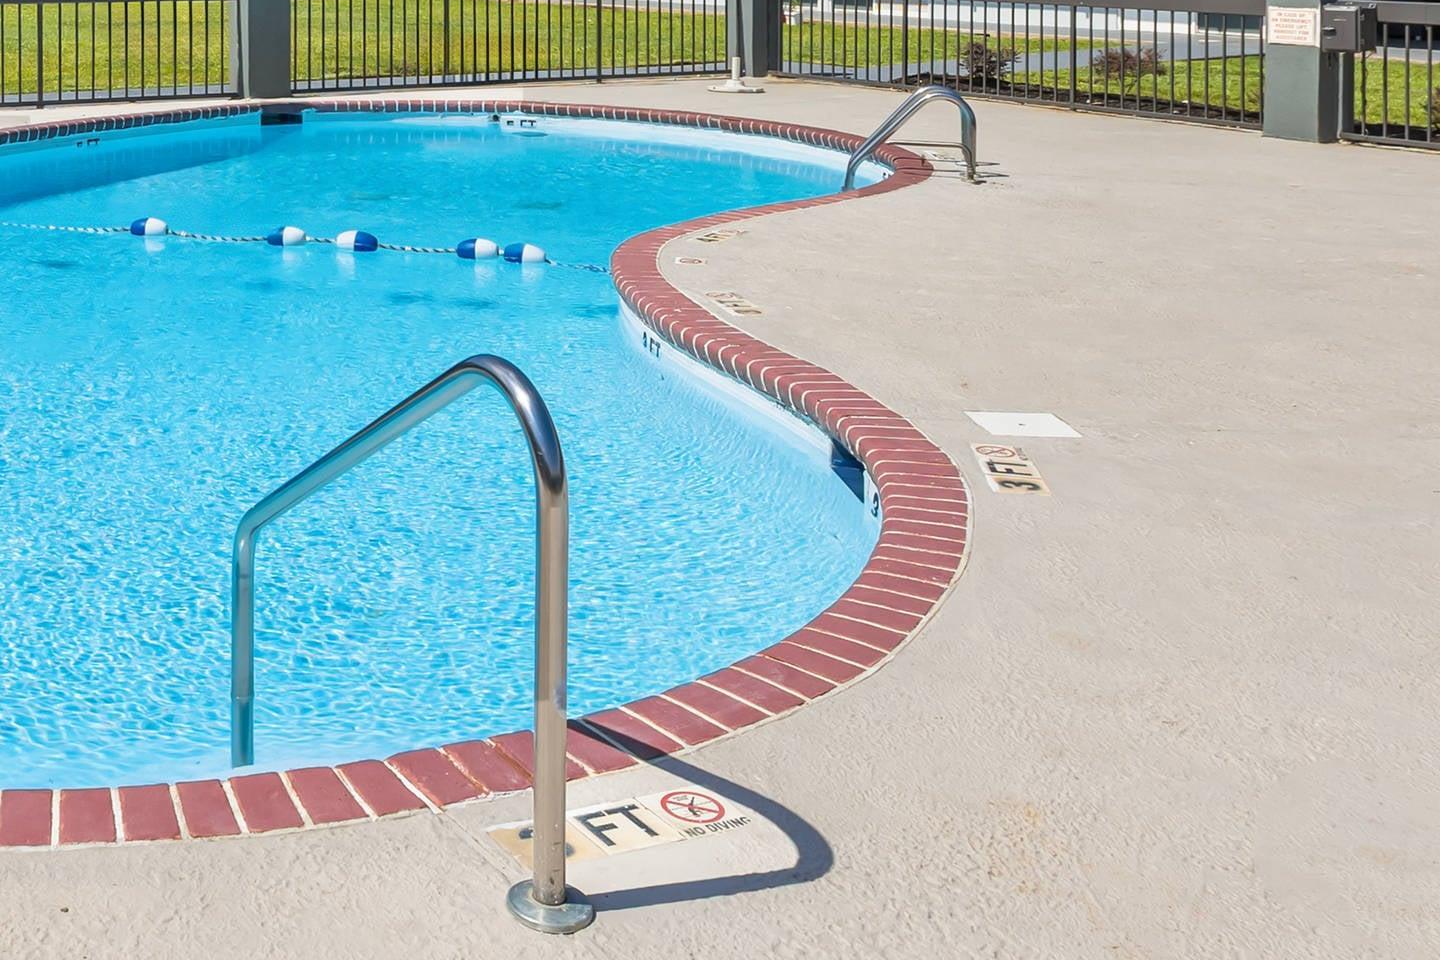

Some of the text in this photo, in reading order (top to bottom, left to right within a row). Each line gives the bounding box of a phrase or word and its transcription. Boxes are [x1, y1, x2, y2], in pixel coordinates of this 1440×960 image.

[985, 458, 1042, 491] 3 FT
[870, 492, 880, 518] 3
[574, 803, 660, 847] FT
[683, 816, 752, 838] NO DIVING
